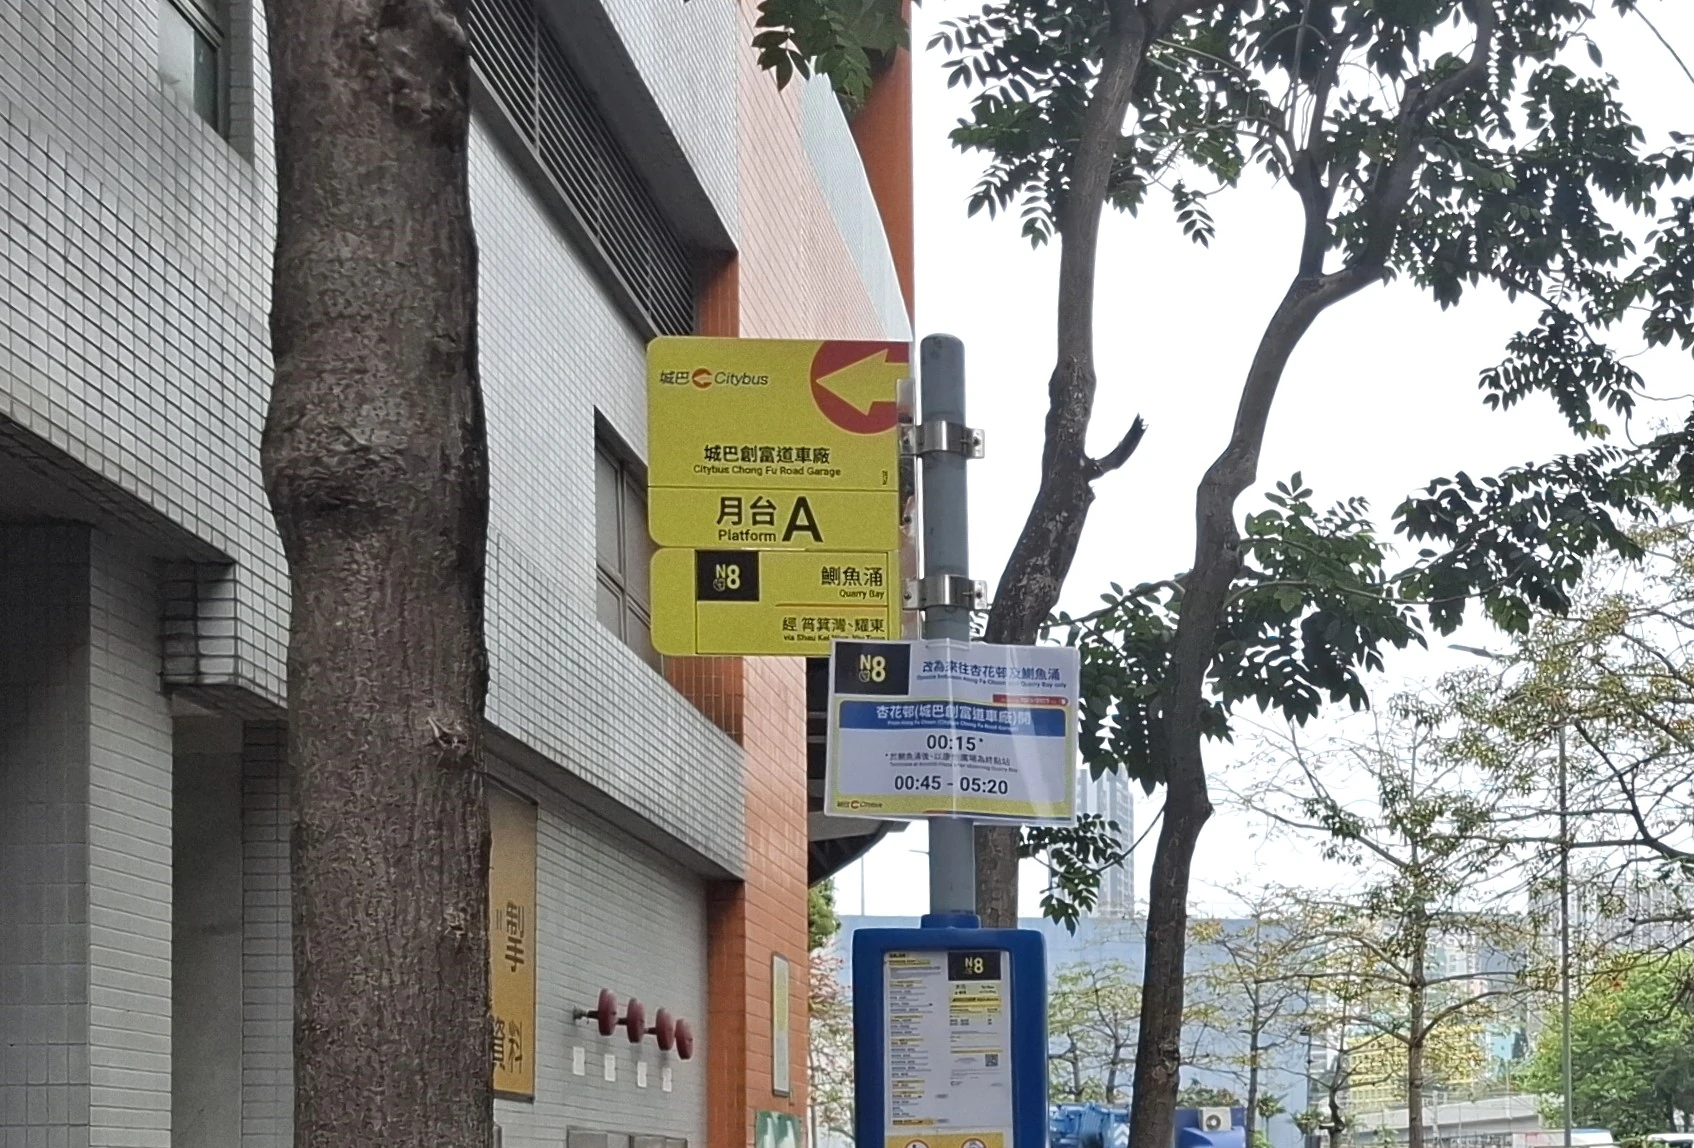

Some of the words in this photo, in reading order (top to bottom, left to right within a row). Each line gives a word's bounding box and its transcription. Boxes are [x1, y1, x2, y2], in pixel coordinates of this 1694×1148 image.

[660, 370, 689, 385] 城巴
[714, 371, 769, 386] Citybus
[704, 445, 830, 464] 城巴創富道車廠
[693, 464, 729, 475] Citybus
[731, 465, 763, 476] Chong
[765, 466, 777, 475] Fu
[780, 466, 804, 476] Road
[807, 467, 841, 478] Garage
[716, 495, 777, 526] 月台
[781, 495, 824, 543] A
[718, 528, 777, 542] Platform
[821, 566, 883, 587] 鰂魚涌
[839, 589, 867, 600] Quarry
[869, 590, 884, 600] Bay
[860, 654, 887, 683] N8
[895, 775, 941, 790] 00:45
[960, 776, 1008, 795] 05:20
